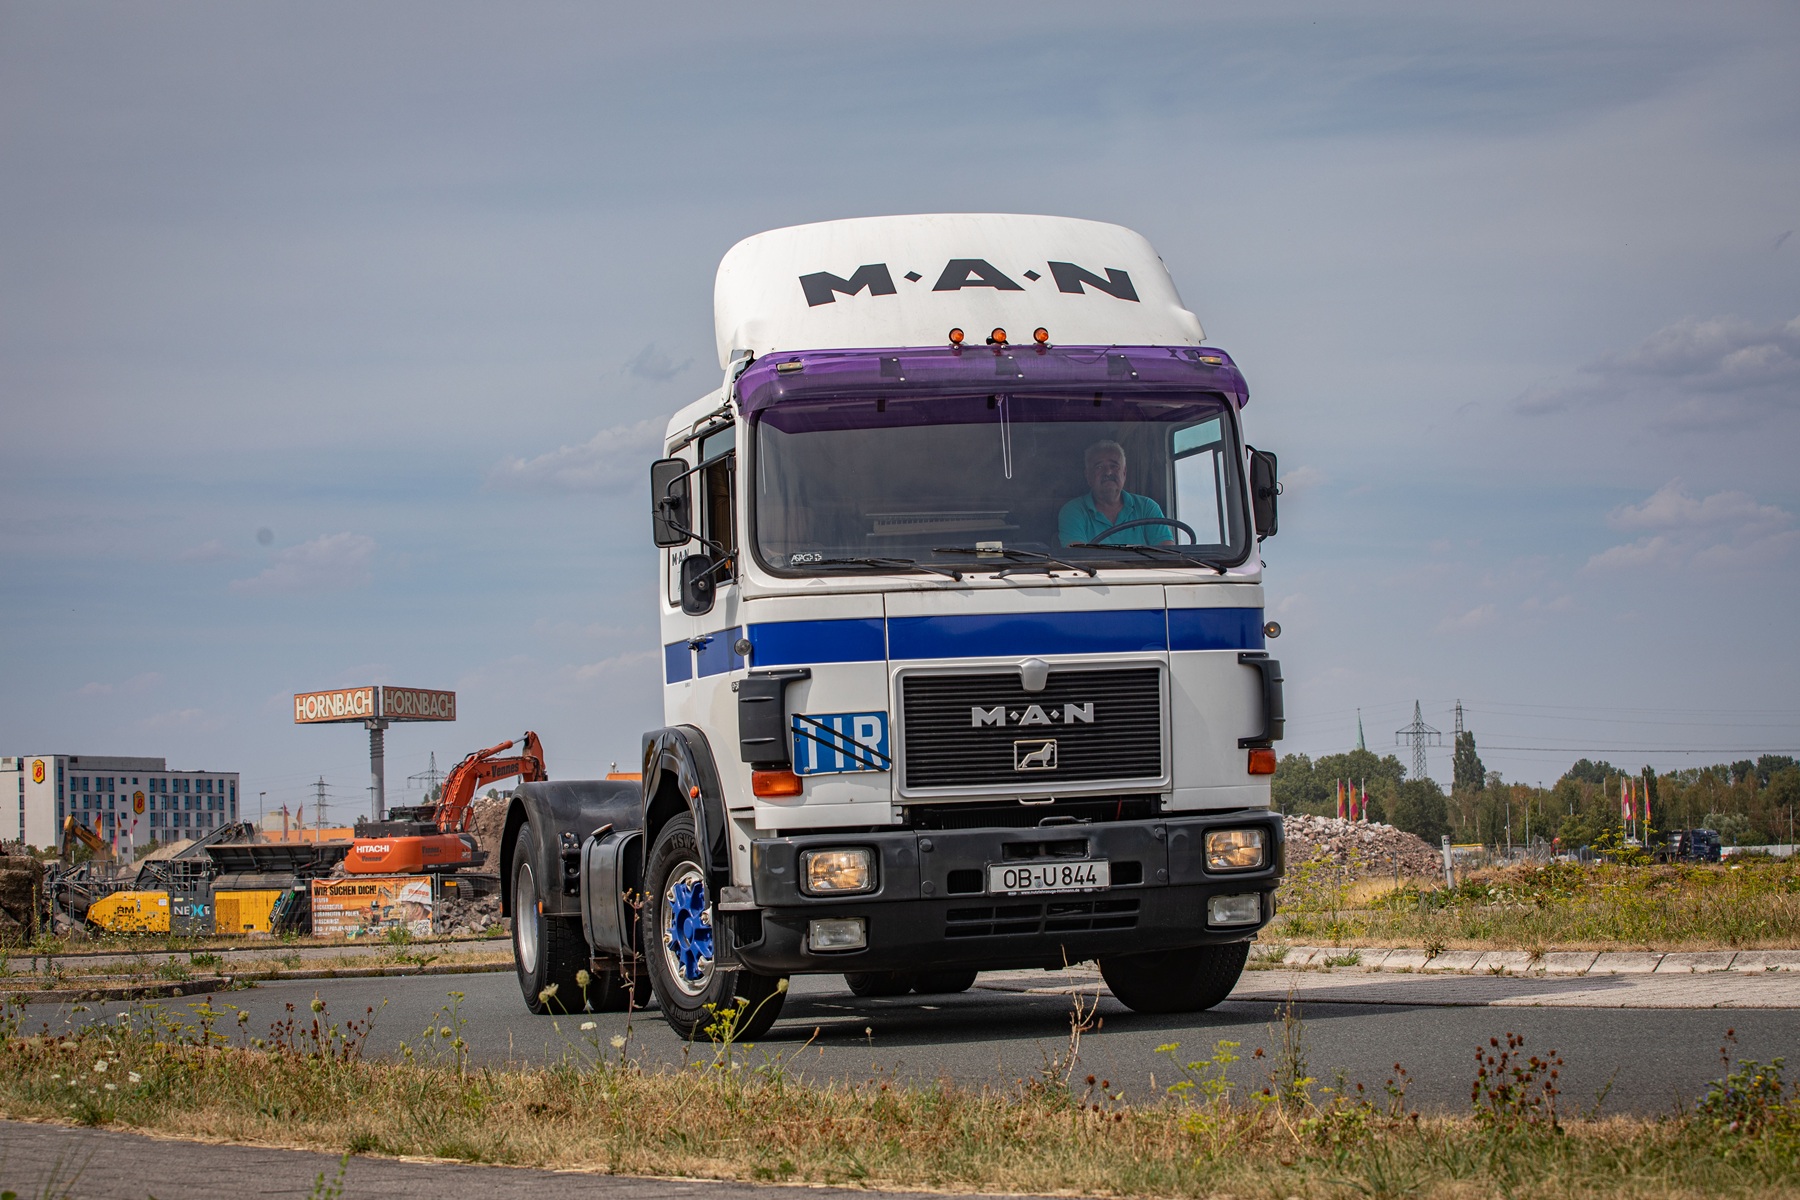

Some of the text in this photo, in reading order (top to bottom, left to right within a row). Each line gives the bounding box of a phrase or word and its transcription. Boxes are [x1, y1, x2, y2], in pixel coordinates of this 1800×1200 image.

[296, 690, 373, 720] HORNBACH
[384, 690, 454, 717] HORNBACH
[800, 715, 883, 769] TIR
[35, 766, 42, 778] 8
[491, 762, 519, 778] Vennes
[136, 798, 142, 809] 8
[356, 845, 390, 853] HITACHI
[1061, 864, 1097, 886] 844
[314, 885, 377, 896] WIR SUCHEN DICH!
[117, 905, 134, 914] RM
